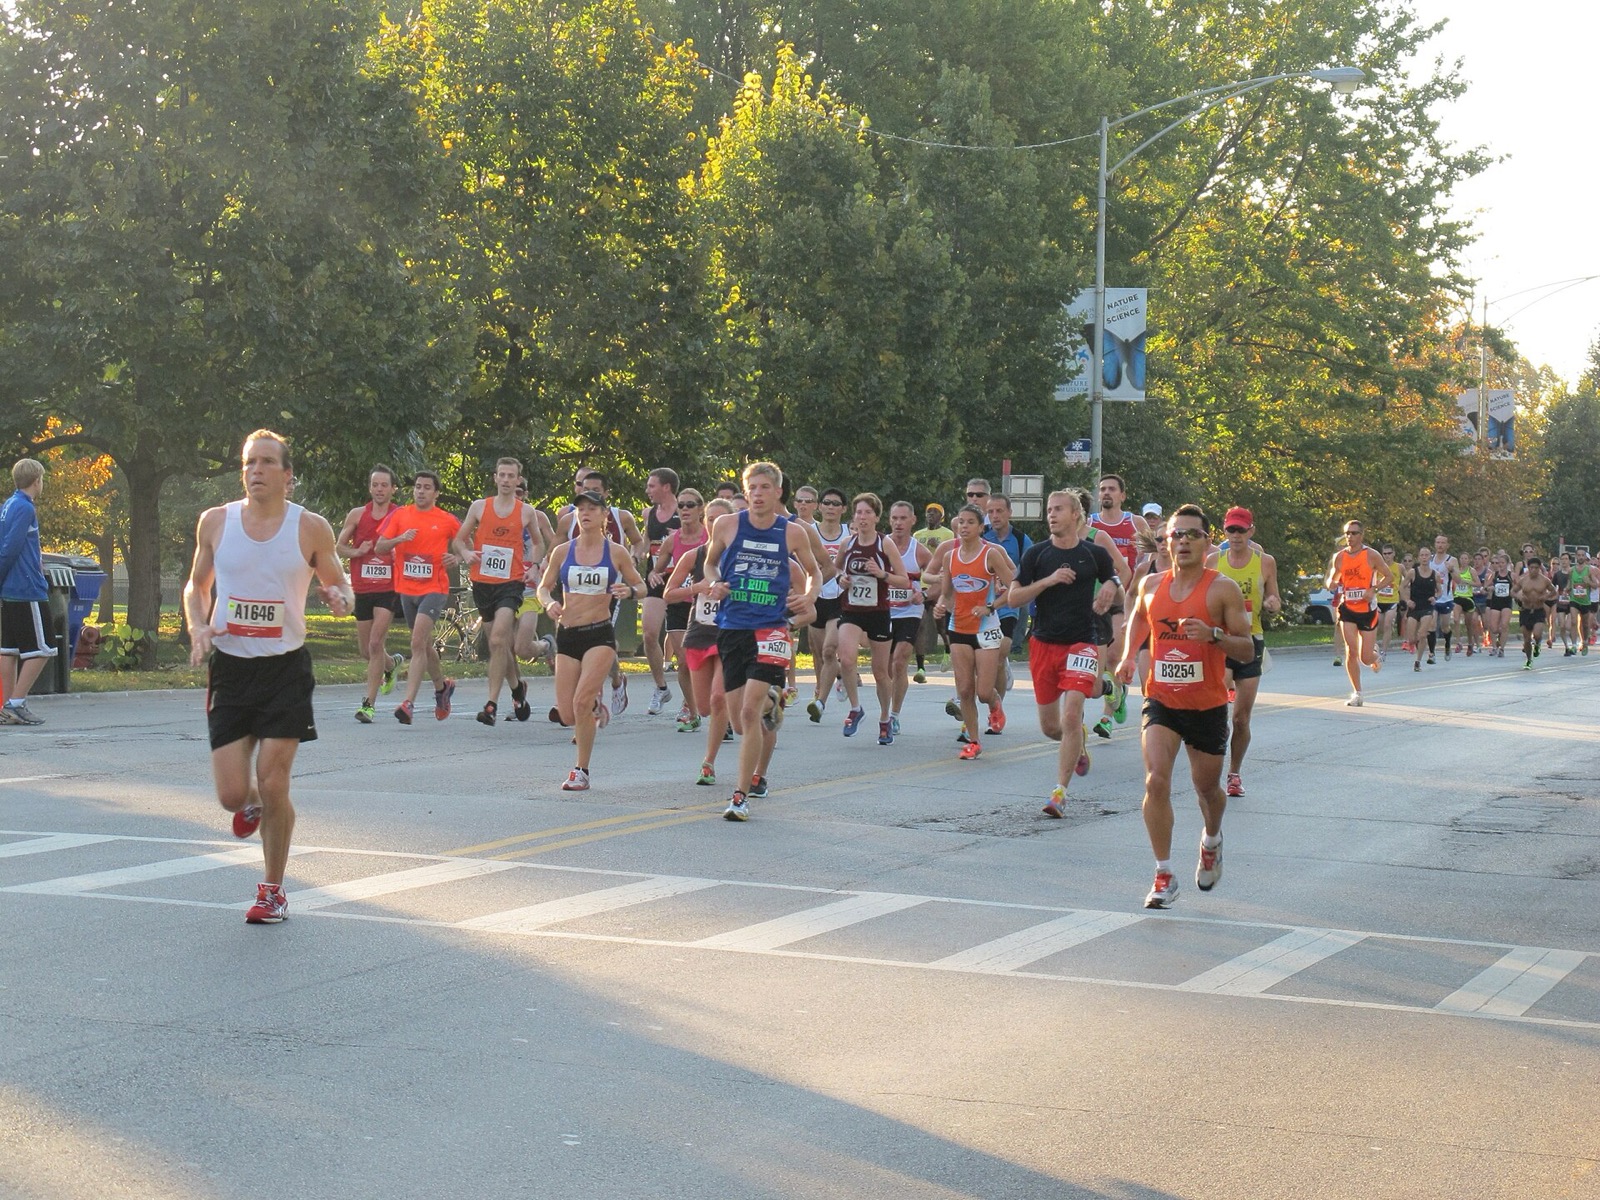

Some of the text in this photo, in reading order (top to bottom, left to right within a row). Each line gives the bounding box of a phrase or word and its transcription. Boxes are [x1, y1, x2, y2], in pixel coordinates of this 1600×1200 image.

[1107, 293, 1139, 310] NATURE
[1106, 307, 1140, 324] SCIENCE
[486, 557, 506, 570] 460
[736, 554, 766, 564] MARATHON
[404, 563, 432, 575] A12115
[576, 573, 601, 586] 140
[740, 577, 770, 592] I RUN
[852, 587, 872, 598] 272
[749, 592, 778, 607] HOPE
[234, 603, 275, 622] A1646
[1159, 631, 1189, 641] MIZUN
[768, 641, 787, 654] A527
[1161, 662, 1196, 679] B3254
